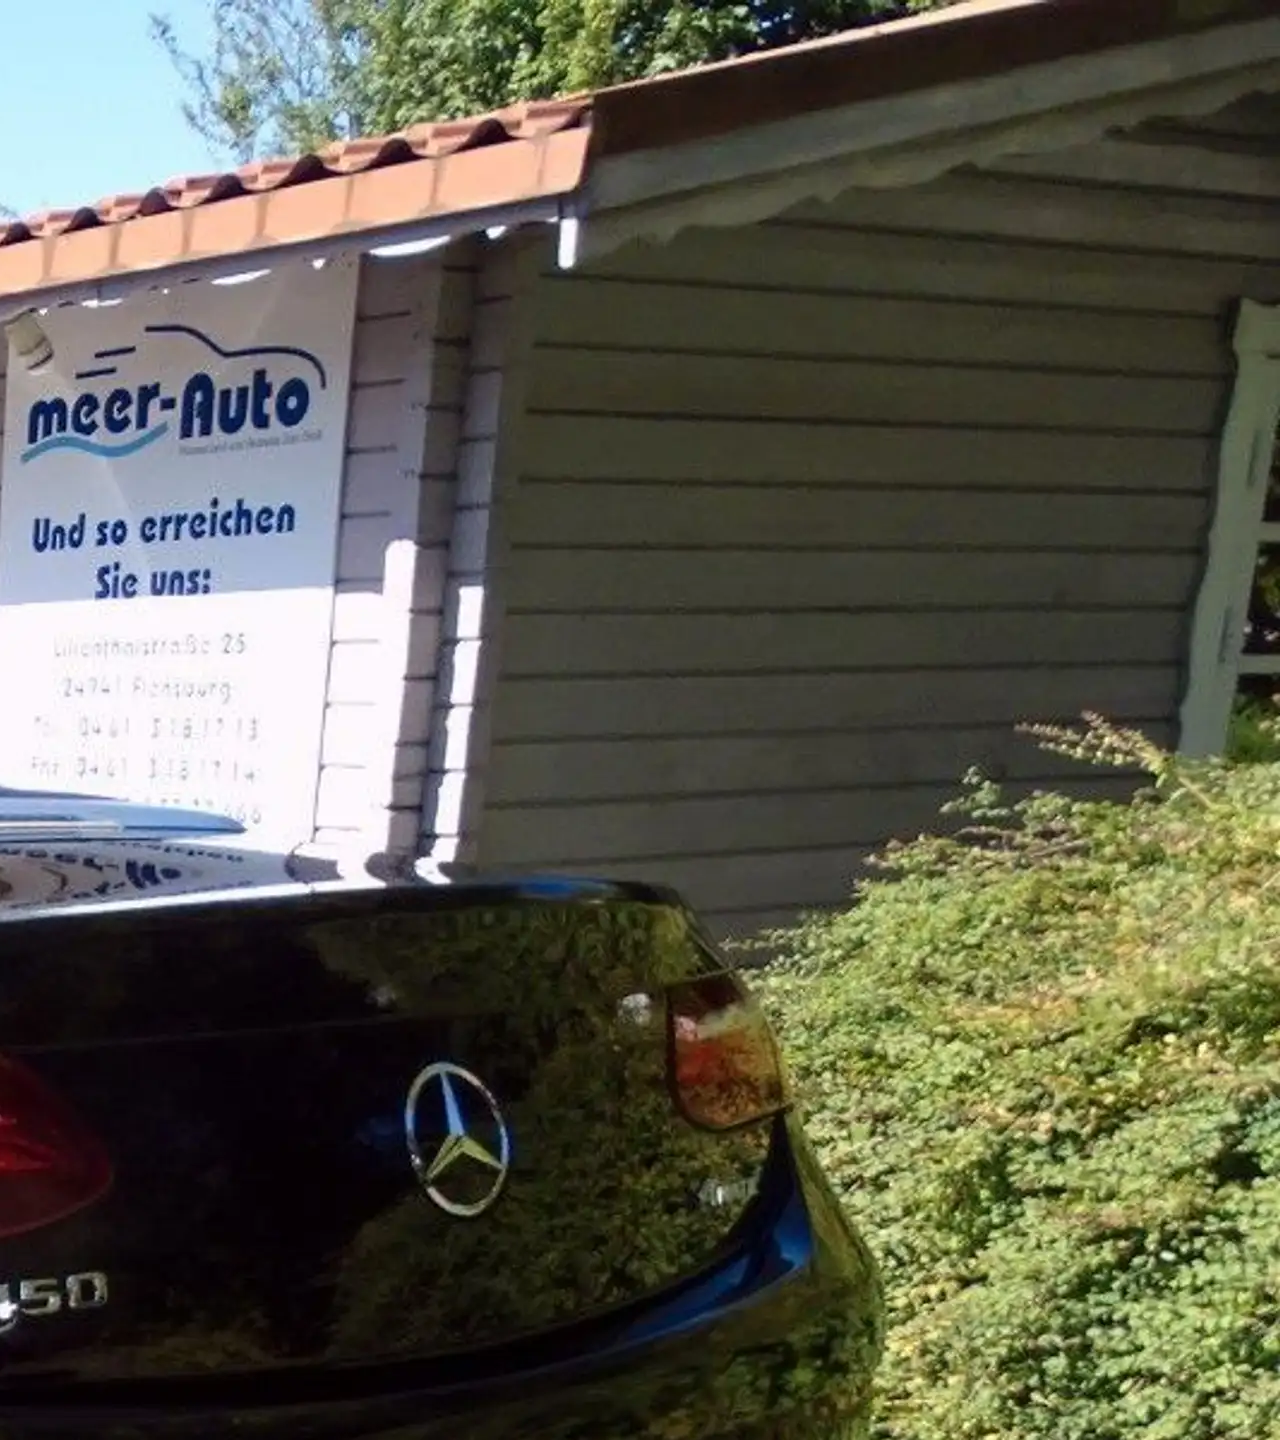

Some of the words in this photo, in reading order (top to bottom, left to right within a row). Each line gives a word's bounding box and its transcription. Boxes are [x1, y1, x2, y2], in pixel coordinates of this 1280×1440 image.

[28, 371, 310, 444] meer-Auto
[32, 512, 86, 552] Und
[95, 519, 129, 546] so
[140, 498, 297, 544] erreichen
[94, 562, 139, 600] Sie
[149, 567, 212, 597] uns:
[221, 632, 247, 655] 25
